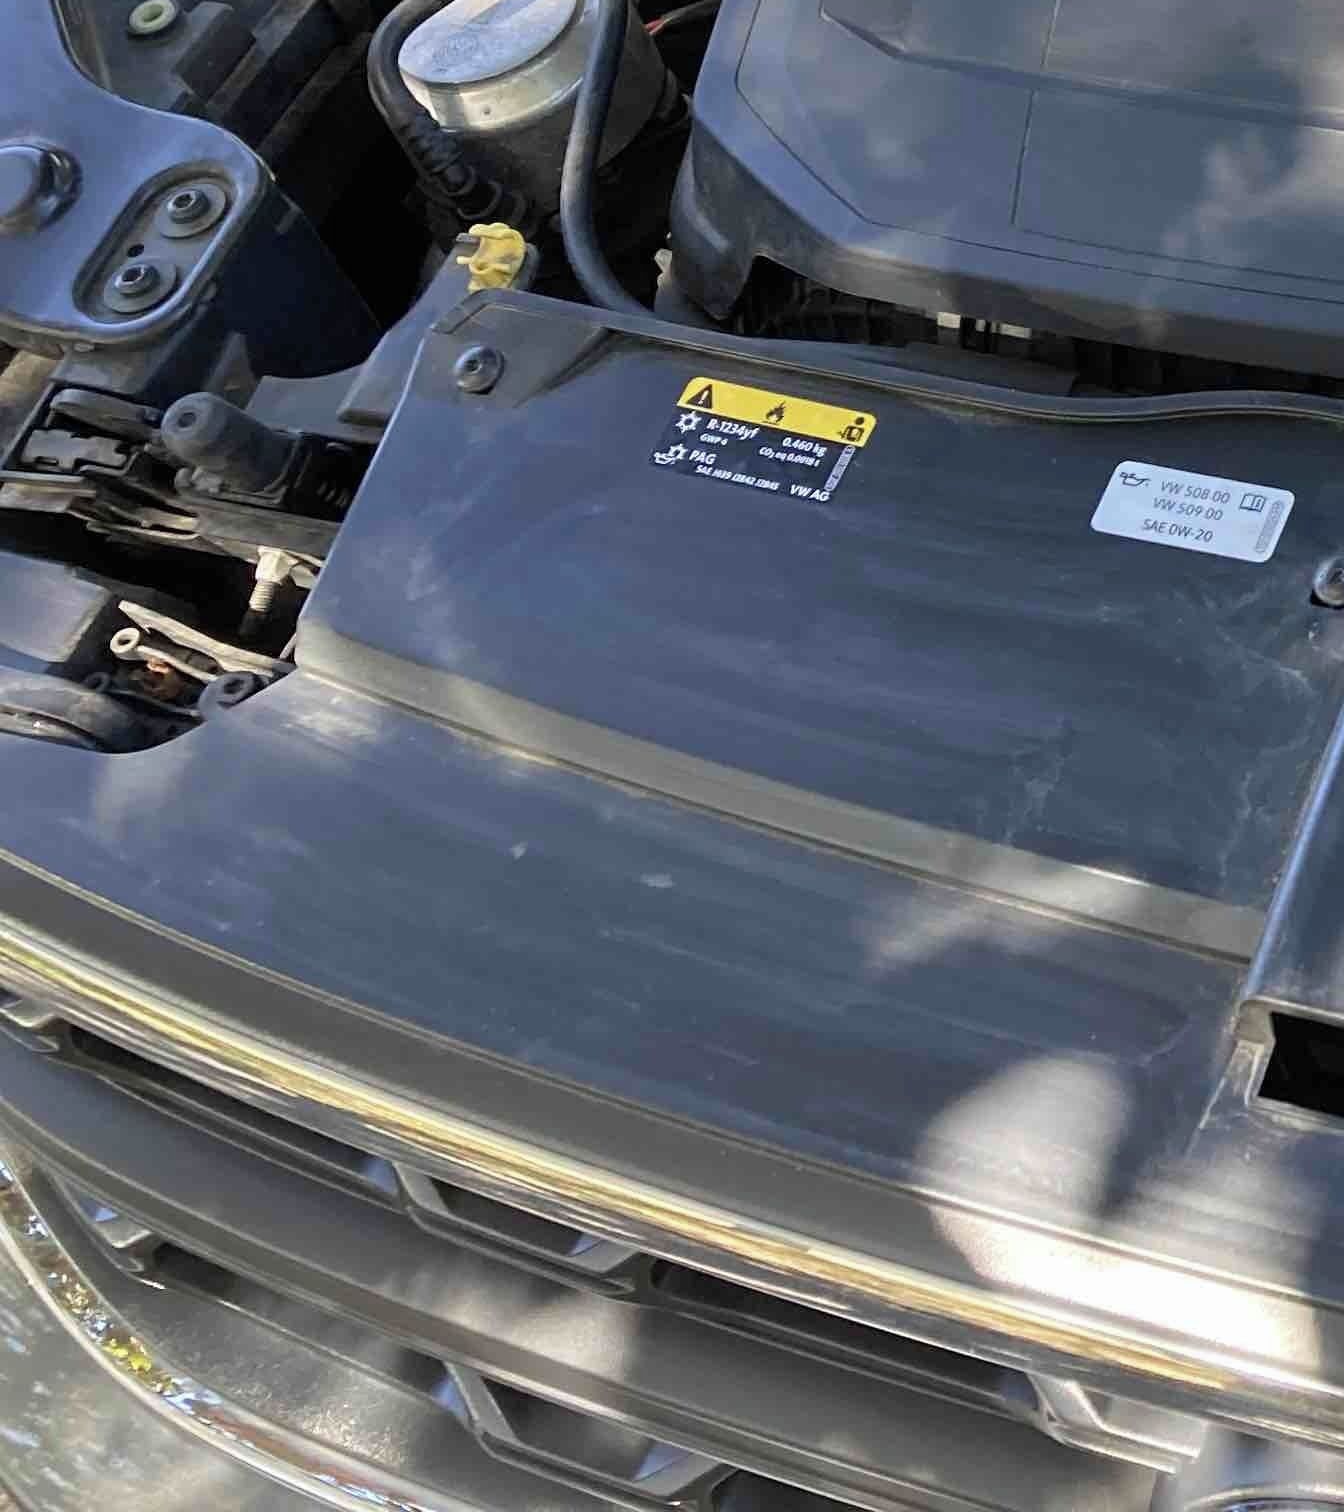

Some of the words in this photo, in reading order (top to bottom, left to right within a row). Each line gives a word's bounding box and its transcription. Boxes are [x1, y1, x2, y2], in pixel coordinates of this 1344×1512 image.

[706, 418, 760, 440] R-1234yf
[689, 450, 717, 465] PAG
[782, 437, 813, 452] 0.460
[813, 443, 828, 457] kg
[696, 465, 713, 476] SAE
[790, 484, 812, 497] VW
[809, 489, 831, 502] AG
[1161, 480, 1184, 495] VW
[1184, 485, 1210, 500] 508
[1212, 490, 1231, 505] 00
[1153, 497, 1176, 511] VW
[1175, 503, 1204, 518] 509
[1205, 506, 1224, 521] 00
[1142, 518, 1169, 534] SAE
[1168, 523, 1214, 543] 0W-20
